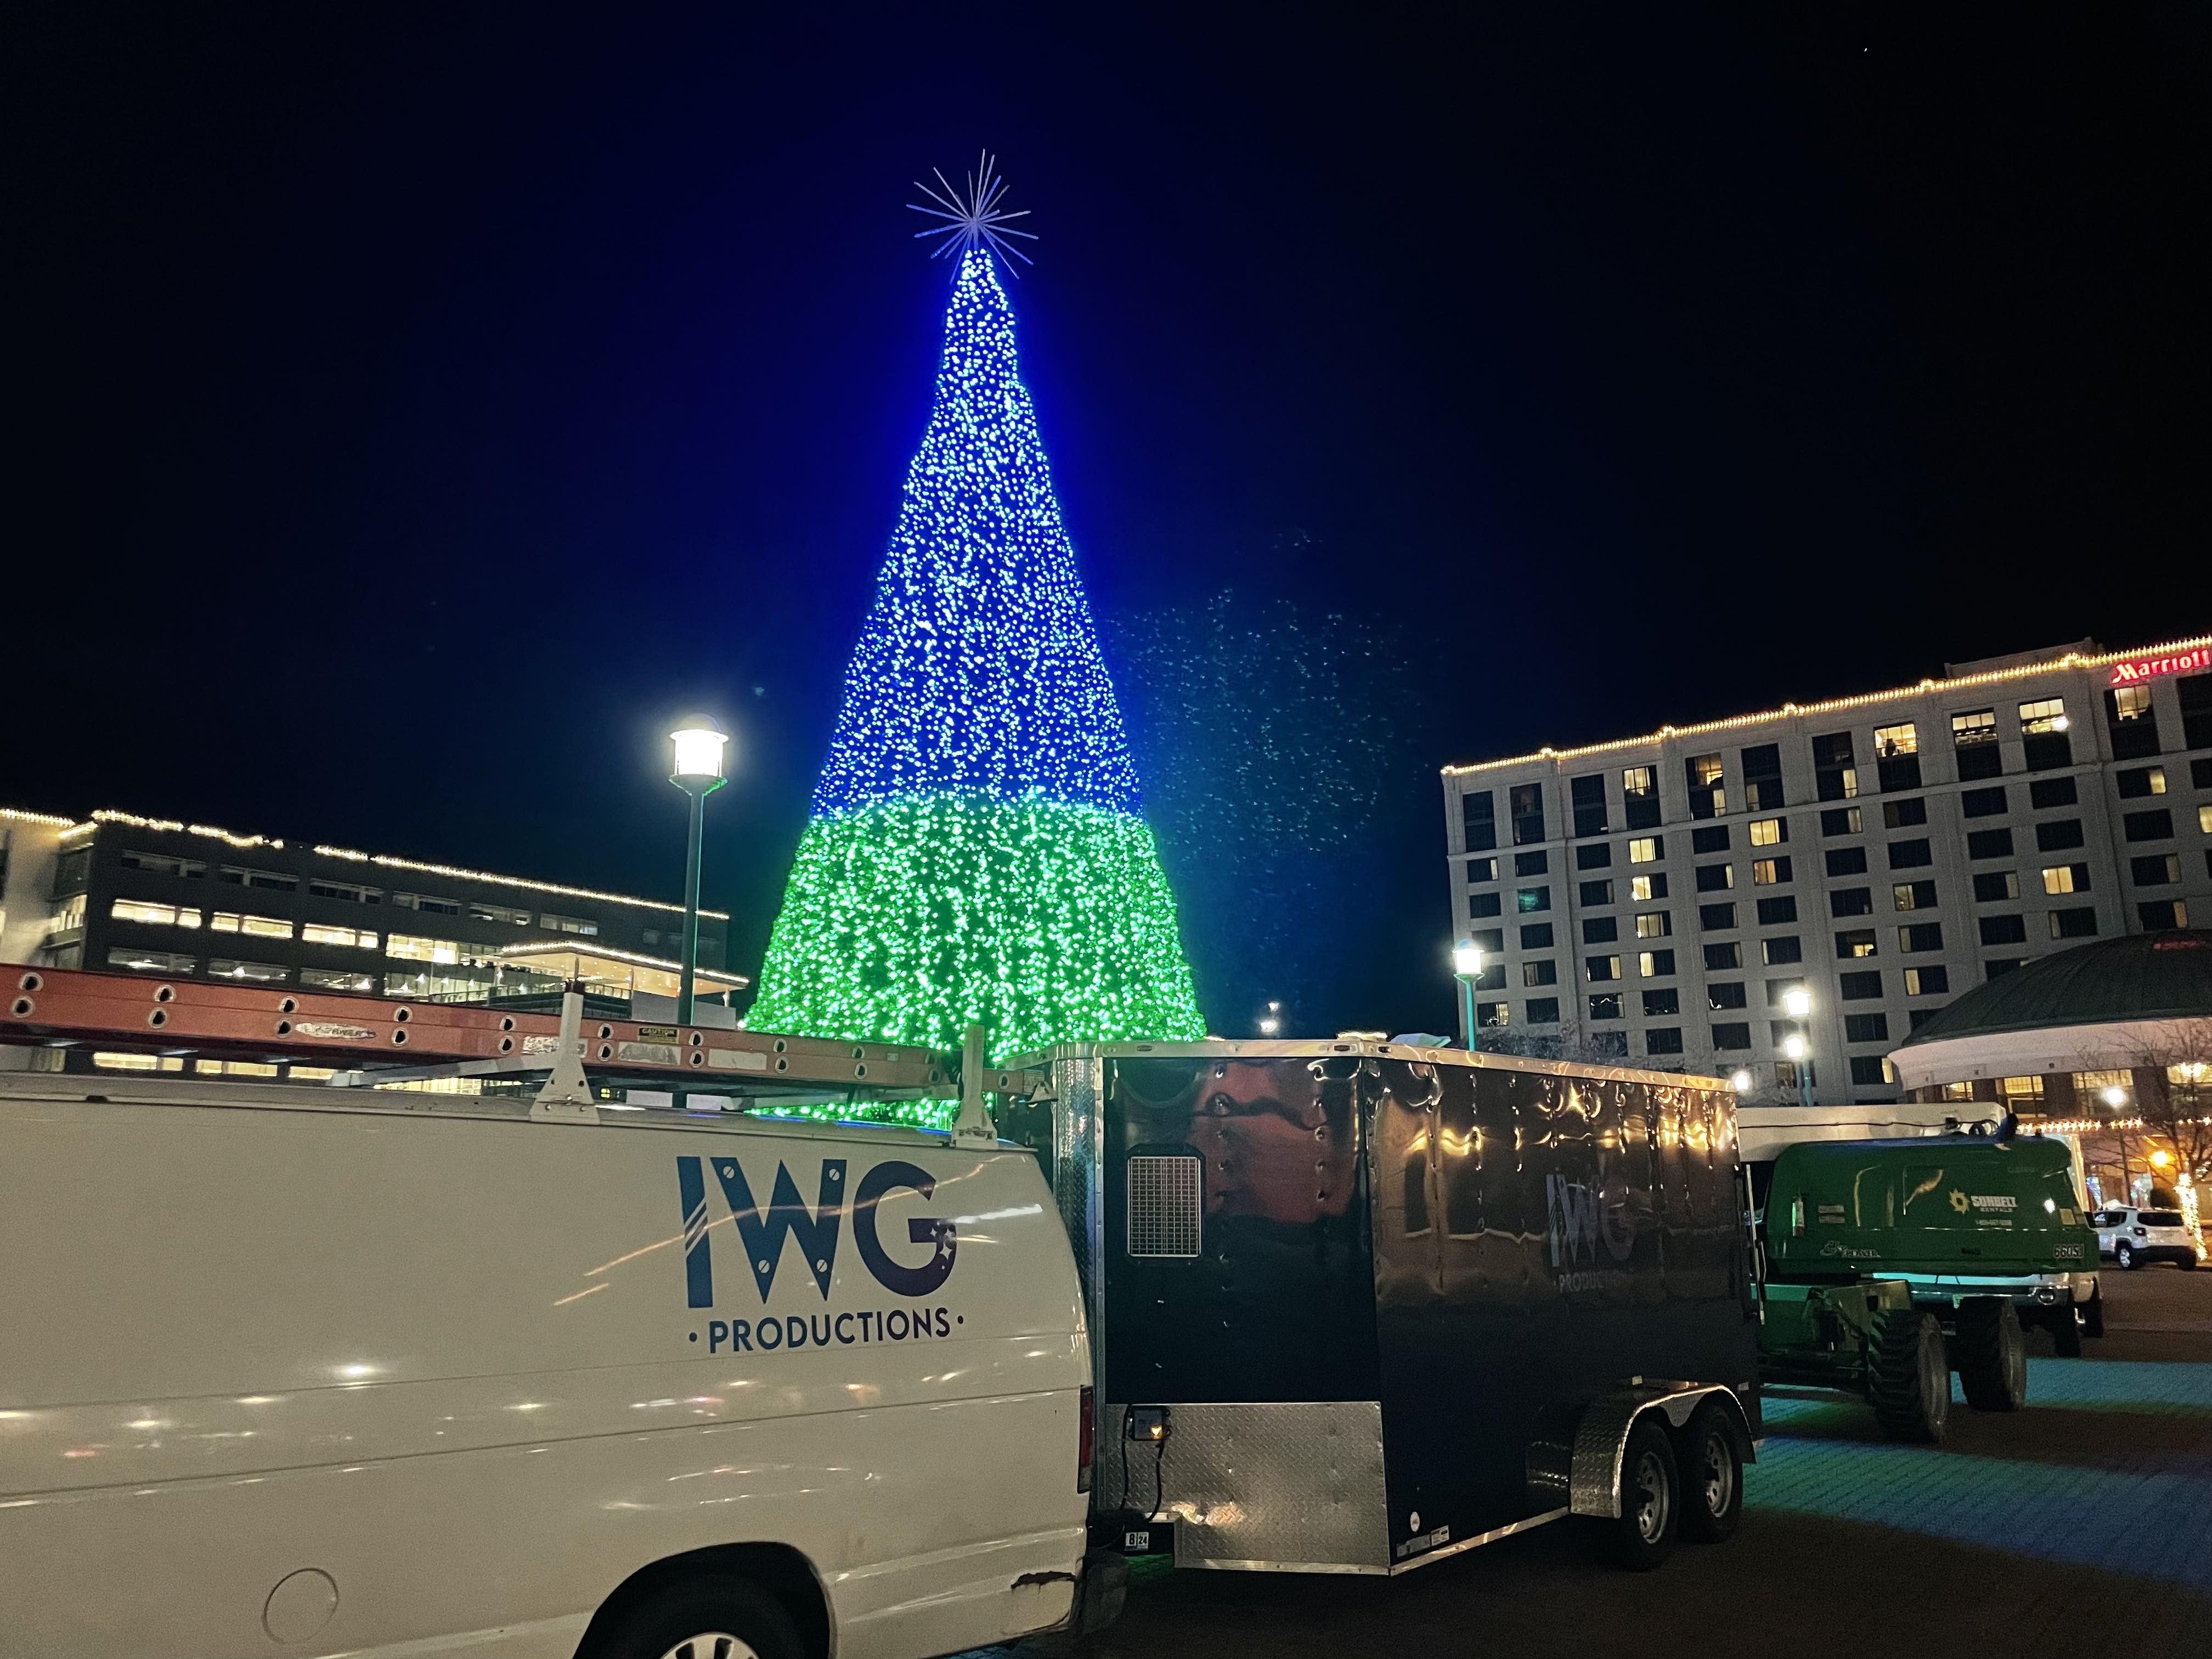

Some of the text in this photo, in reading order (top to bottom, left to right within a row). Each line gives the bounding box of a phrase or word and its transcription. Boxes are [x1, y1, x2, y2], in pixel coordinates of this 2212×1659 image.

[2111, 649, 2210, 684] Marriott
[676, 1156, 957, 1308] IWG
[709, 1307, 951, 1353] PRODUCTIONS
[1129, 1533, 1147, 1545] 8 24
